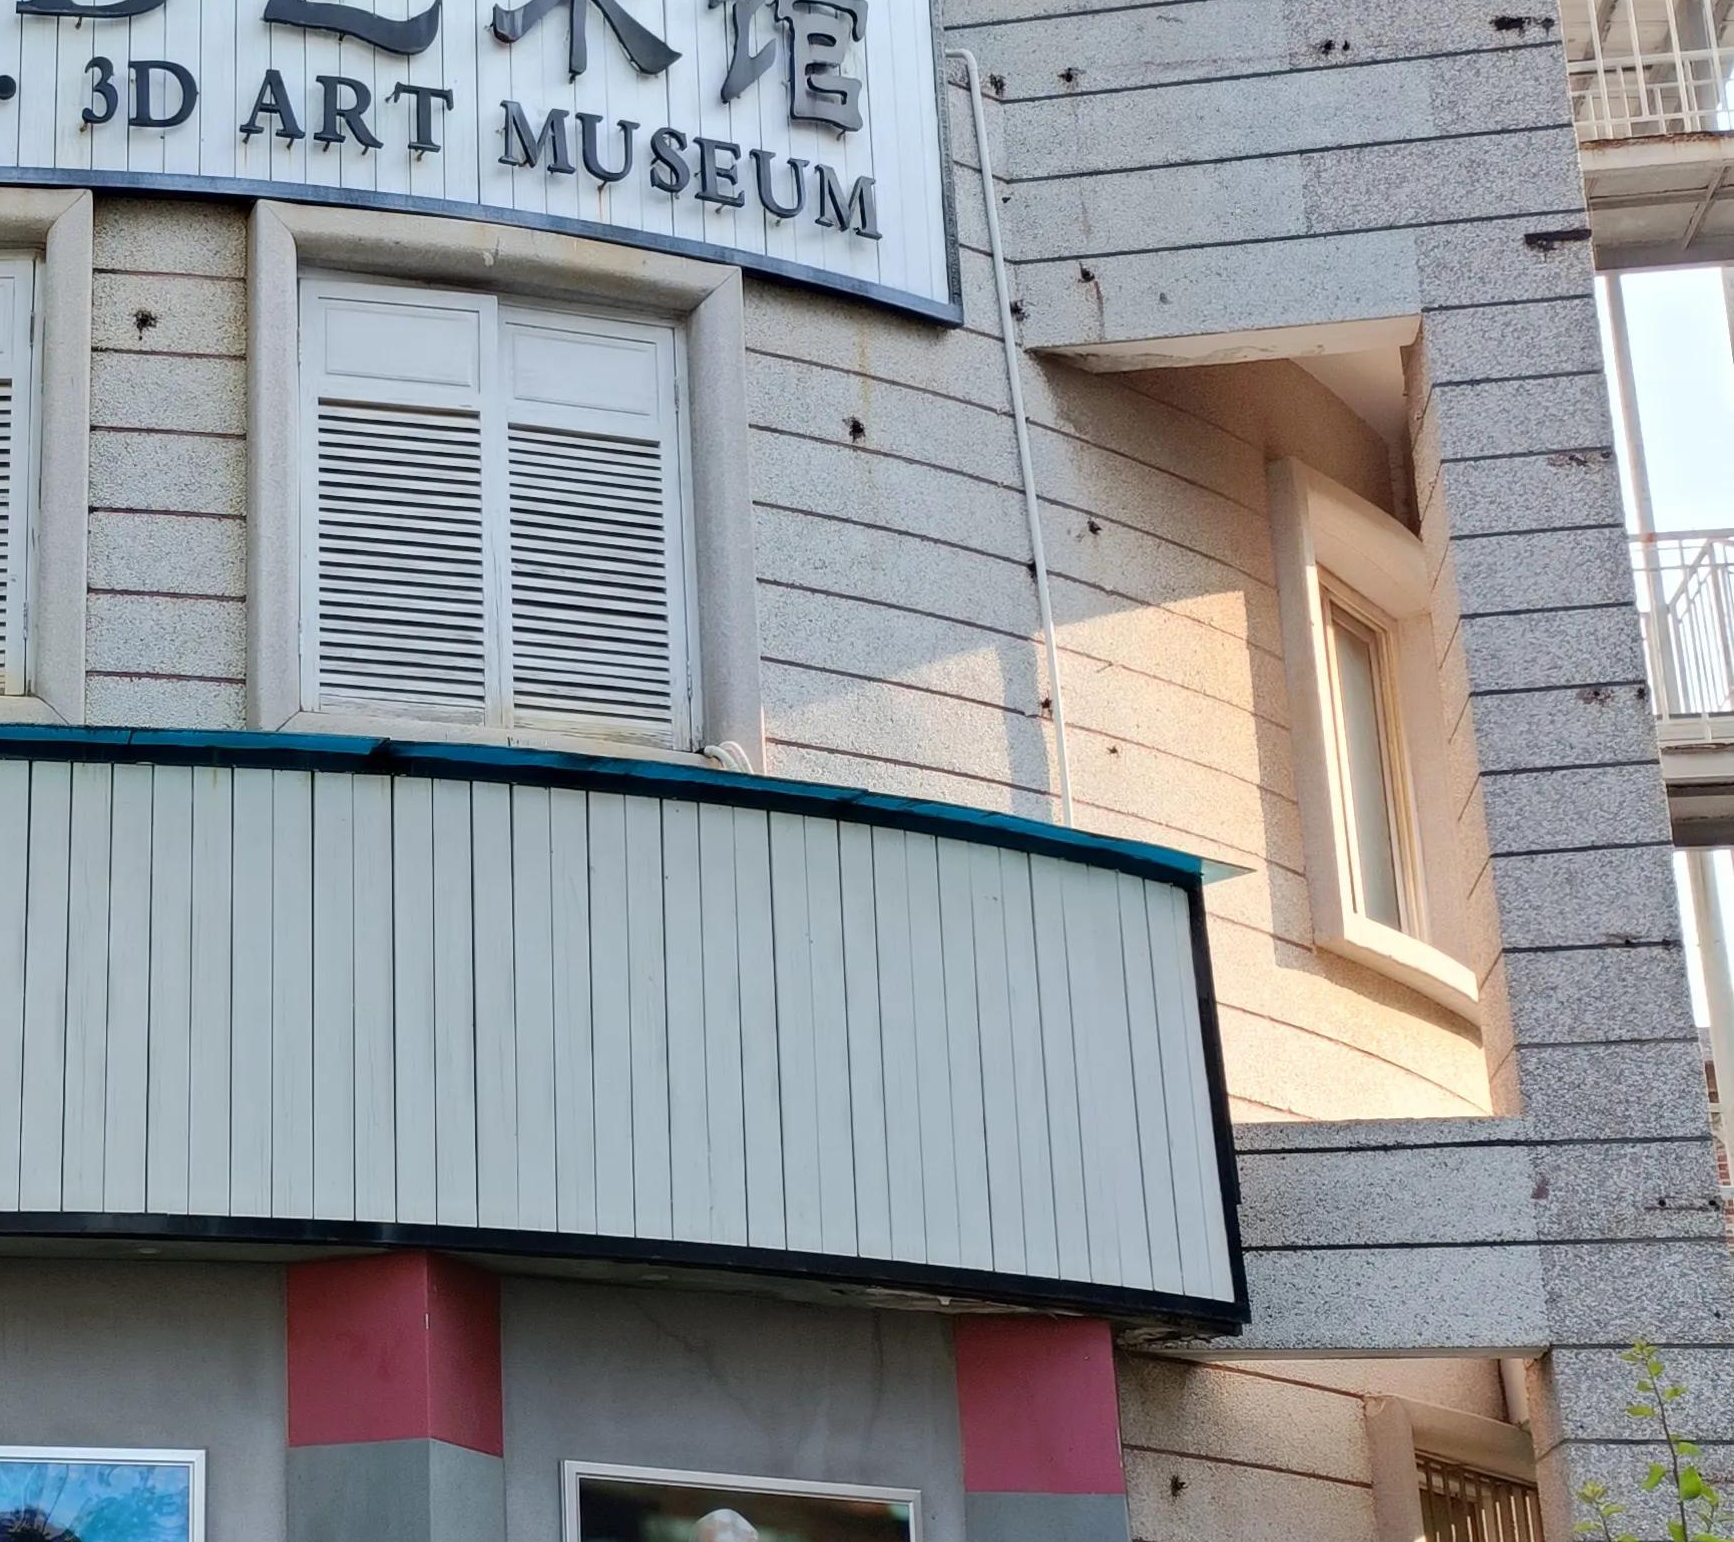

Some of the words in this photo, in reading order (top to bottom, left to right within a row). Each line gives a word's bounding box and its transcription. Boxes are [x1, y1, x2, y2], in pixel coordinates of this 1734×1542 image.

[82, 56, 199, 129] 3D
[239, 68, 454, 153] ART
[497, 99, 884, 240] MUSEUM
